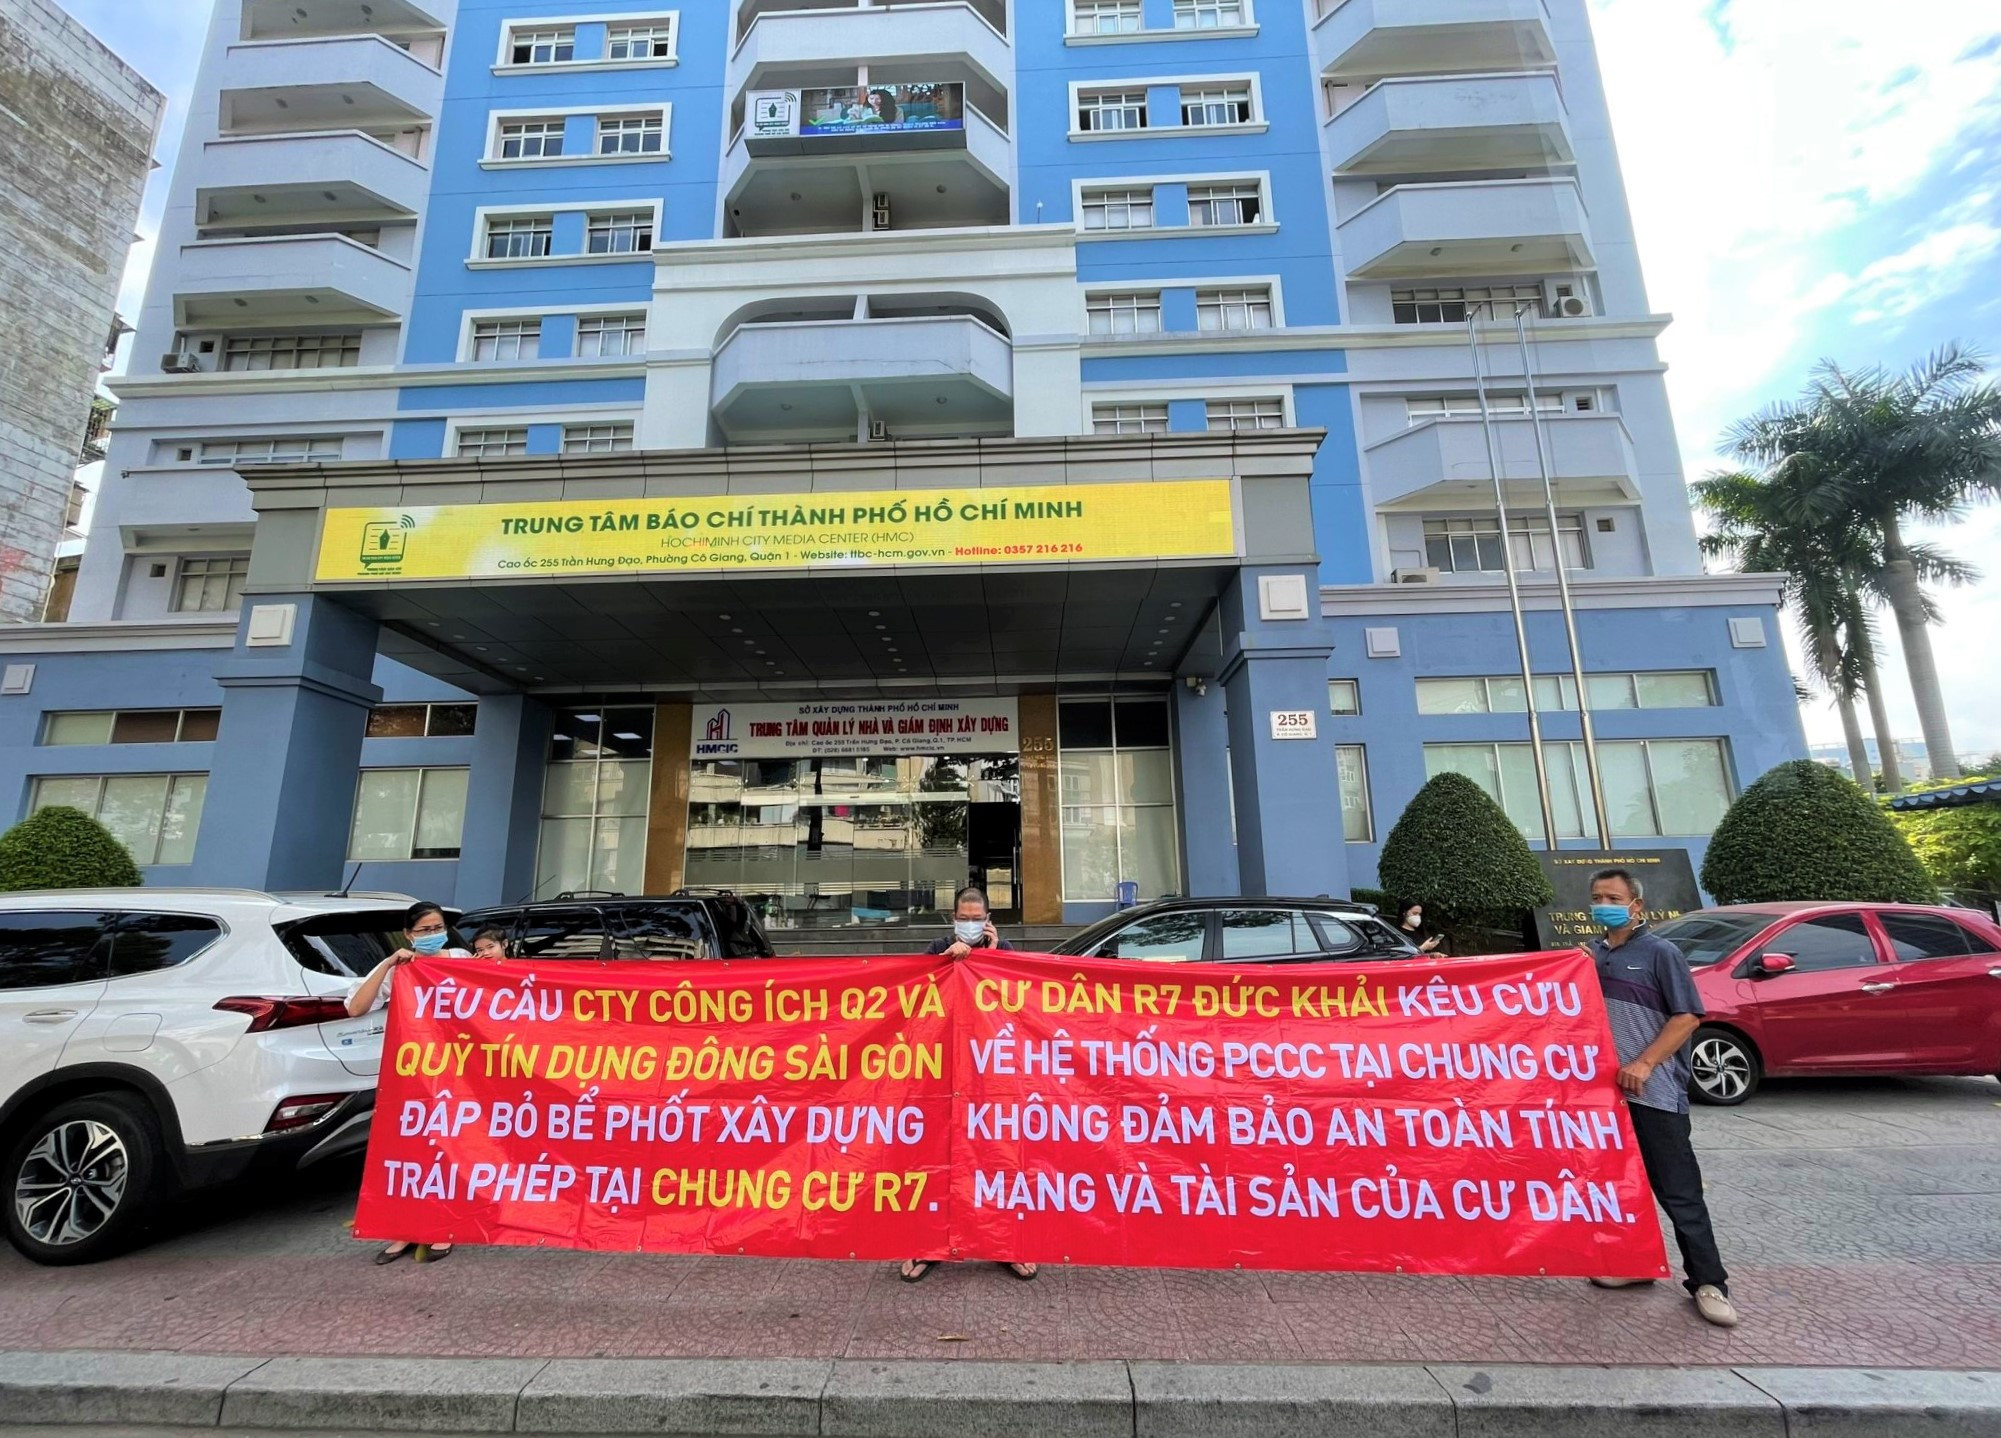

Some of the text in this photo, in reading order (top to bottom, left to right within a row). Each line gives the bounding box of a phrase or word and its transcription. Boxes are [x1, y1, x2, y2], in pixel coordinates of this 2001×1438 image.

[501, 498, 1083, 534] TRUNG TÂM BÁO CHÍ THÀNH PHỐ HỒ CHÍ MINH
[661, 531, 914, 548] HOCHIMINH CITY MEDIA CENTER (HMC)
[497, 560, 521, 569] Cao
[523, 557, 538, 568] ốc
[540, 558, 559, 567] 255
[561, 556, 583, 566] Trần
[586, 557, 615, 567] Hưng
[618, 556, 643, 567] Đạo,
[646, 553, 688, 564] Phường
[691, 553, 707, 562] Cô
[709, 553, 747, 563] Giang,
[749, 552, 781, 562] Quận
[785, 551, 790, 560] 1
[800, 550, 848, 560] Website:
[955, 546, 1001, 556] Hotline:
[1004, 544, 1033, 555] 0357
[1036, 544, 1058, 554] 216
[1060, 543, 1083, 553] 216
[813, 705, 829, 714] XÂY
[831, 706, 855, 715] DỰNG
[1277, 713, 1308, 726] 255
[749, 715, 1008, 737] TRUNG TÂM QUẢN LÝ NHÀ VÀ GIÁM ĐỊNH XÂY DỰNG
[696, 743, 739, 754] HMCIC
[1023, 736, 1054, 751] 255
[1548, 911, 1587, 922] TRUNG
[1554, 923, 1571, 935] VÀ
[413, 973, 946, 1023] YÊU CẦU CTY CÔNG ÍCH Q2 VÀ
[973, 971, 1582, 1018] CƯ DÂN R7 ĐỨC KHẢI KÊU CỨU
[395, 1032, 943, 1091] QUỸ TÍN DỤNG ĐÔNG SÀI GÒN
[969, 1022, 1599, 1088] VỀ HỆ THỐNG PCCC TẠI CHUNG CƯ
[399, 1085, 924, 1154] ĐẬP BỎ BỂ PHỐT XÂY DỰNG
[967, 1091, 1623, 1150] KHÔNG ĐẢM BẢO AN TOÀN TÍNH
[383, 1151, 938, 1214] TRÁI PHÉP TẠI CHUNG CƯ R7.
[973, 1161, 1636, 1224] MẠNG VÀ TÀI SẢN CỦA CƯ DÂN.
